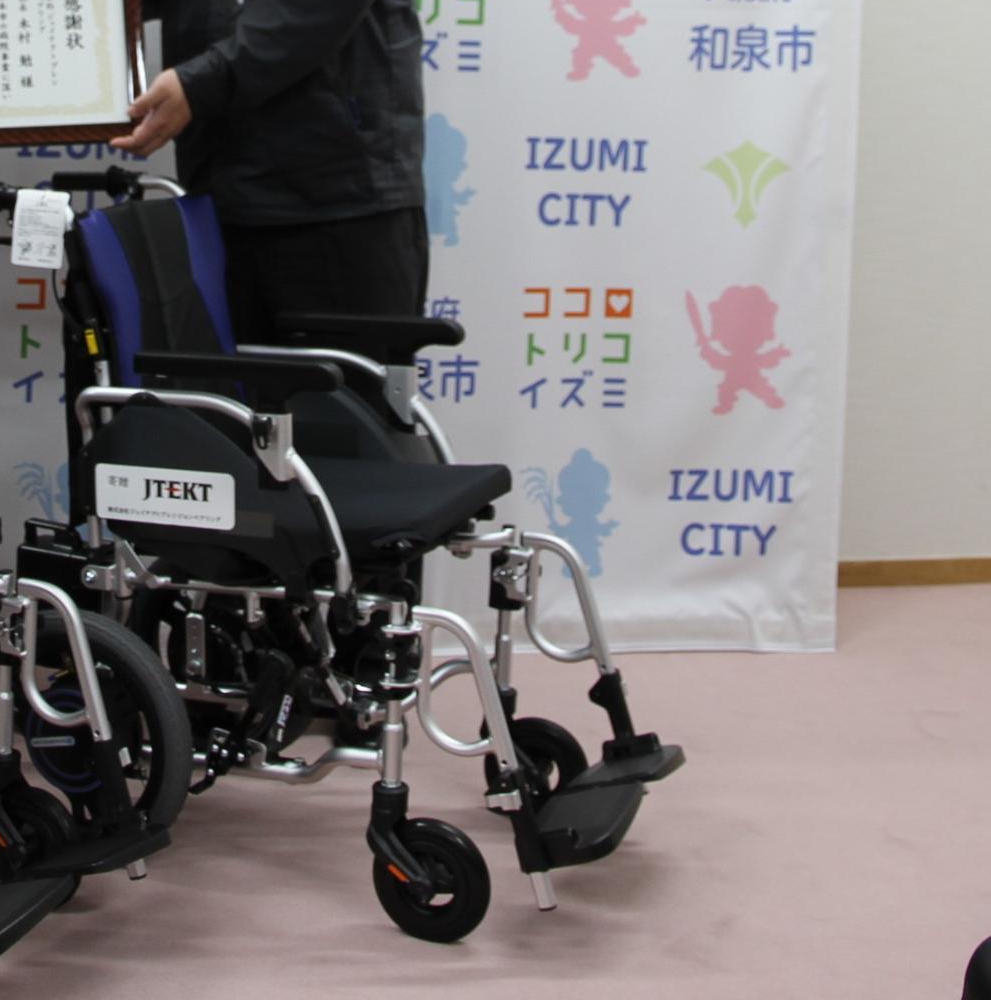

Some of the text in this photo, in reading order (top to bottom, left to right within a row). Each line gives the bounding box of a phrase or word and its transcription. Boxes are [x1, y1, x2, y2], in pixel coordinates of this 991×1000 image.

[421, 32, 482, 72] ズミ
[689, 25, 815, 72] 和泉市
[526, 138, 647, 172] IZUMI
[539, 193, 630, 227] CITY
[527, 333, 631, 366] トリコ
[520, 371, 626, 408] イズミ
[143, 478, 213, 503] JTEKT
[668, 469, 793, 503] IZUMI
[681, 523, 776, 556] CITY
